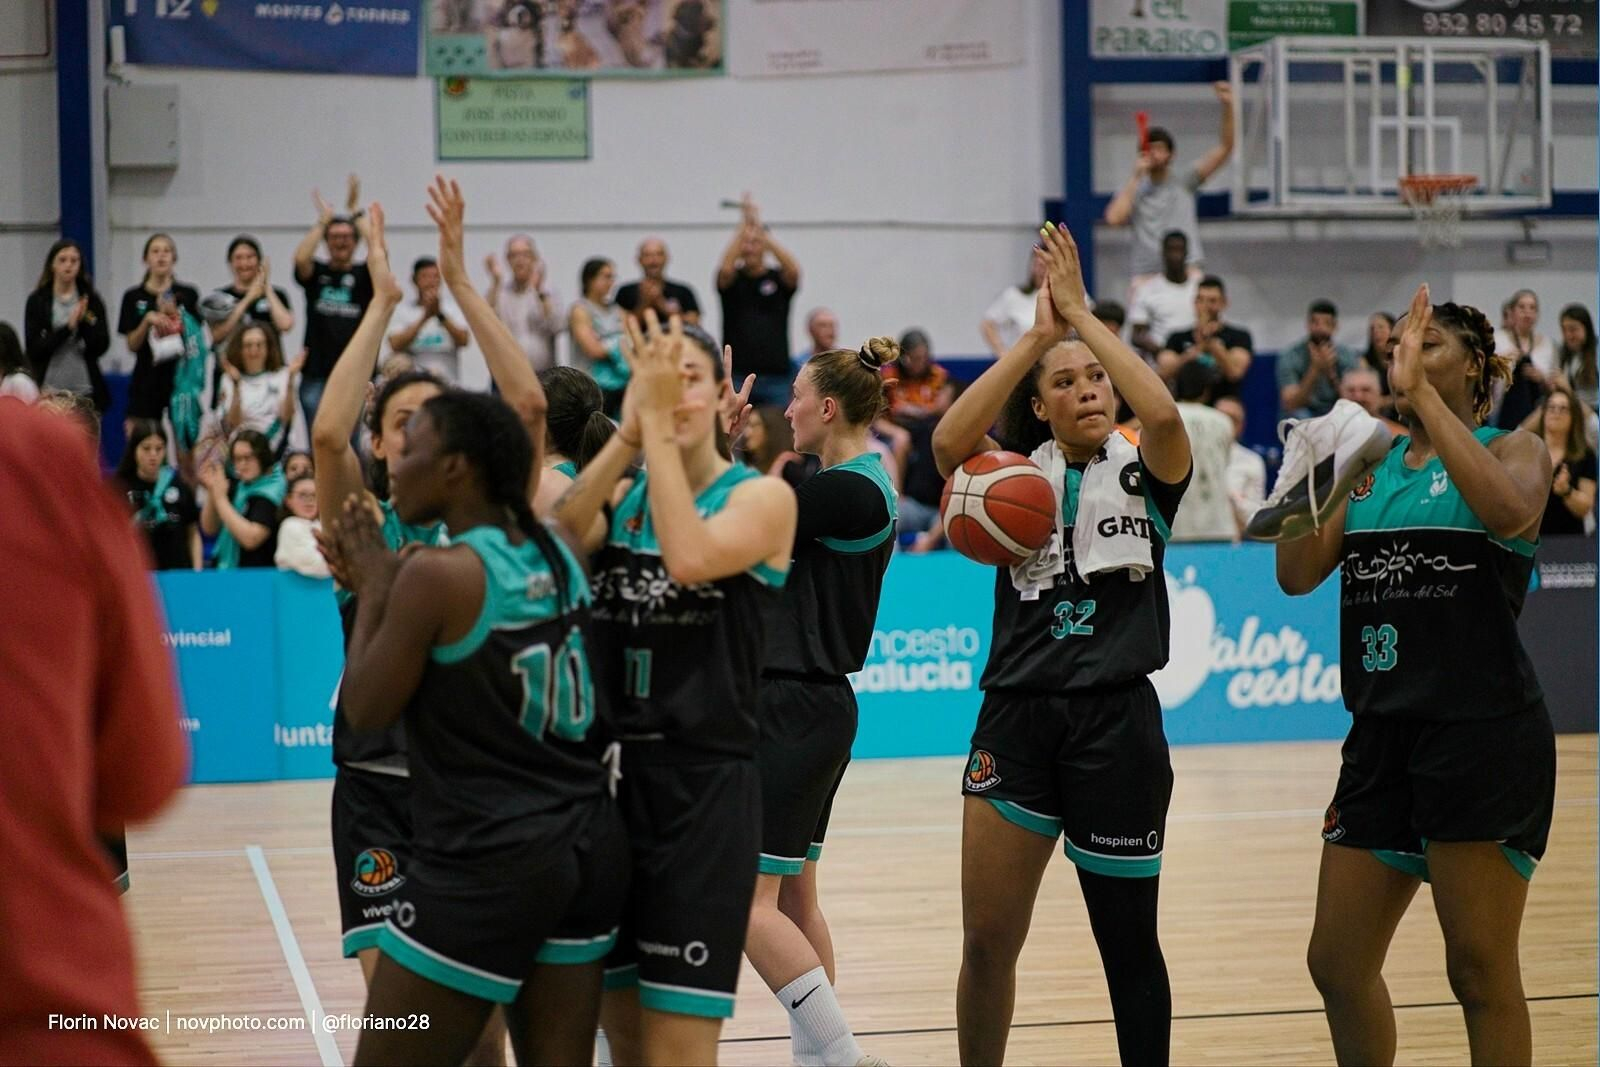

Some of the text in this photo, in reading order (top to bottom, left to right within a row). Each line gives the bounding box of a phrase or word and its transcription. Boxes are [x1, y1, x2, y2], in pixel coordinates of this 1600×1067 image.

[1422, 12, 1583, 36] 952 80 45 72
[1051, 600, 1096, 639] 32
[1362, 624, 1398, 672] 33
[511, 626, 595, 742] 10
[1091, 833, 1143, 848] hospiten
